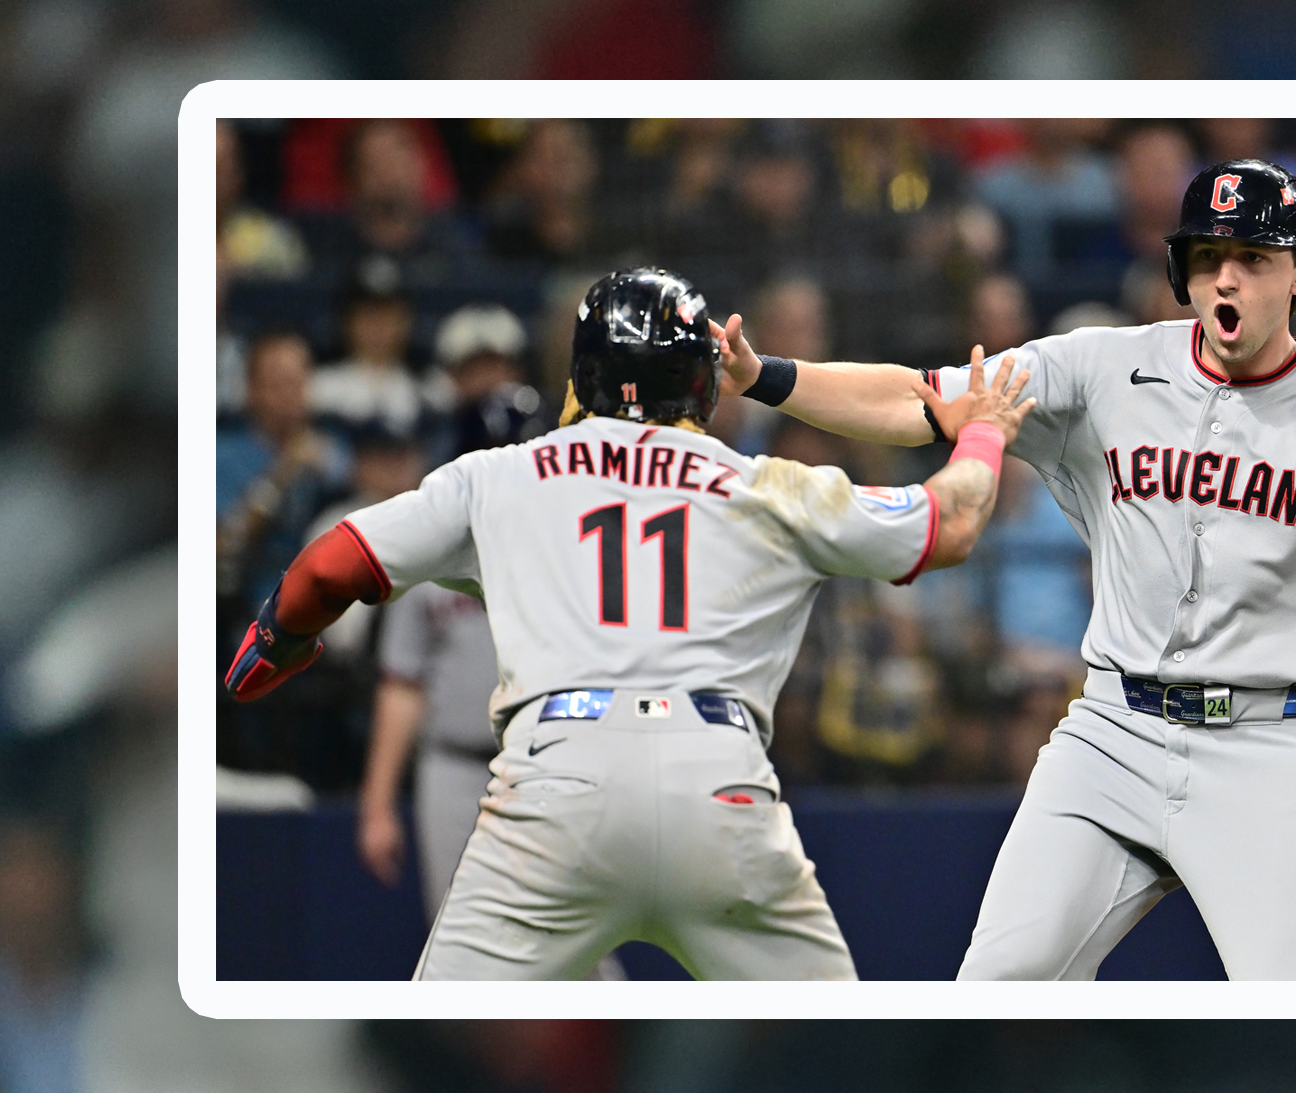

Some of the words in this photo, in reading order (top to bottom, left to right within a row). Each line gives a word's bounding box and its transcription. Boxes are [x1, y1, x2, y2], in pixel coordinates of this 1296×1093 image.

[1210, 173, 1243, 212] C
[620, 382, 638, 403] 11
[532, 428, 741, 499] RAMÍREZ
[577, 501, 690, 632] 11
[1207, 698, 1228, 717] 24
